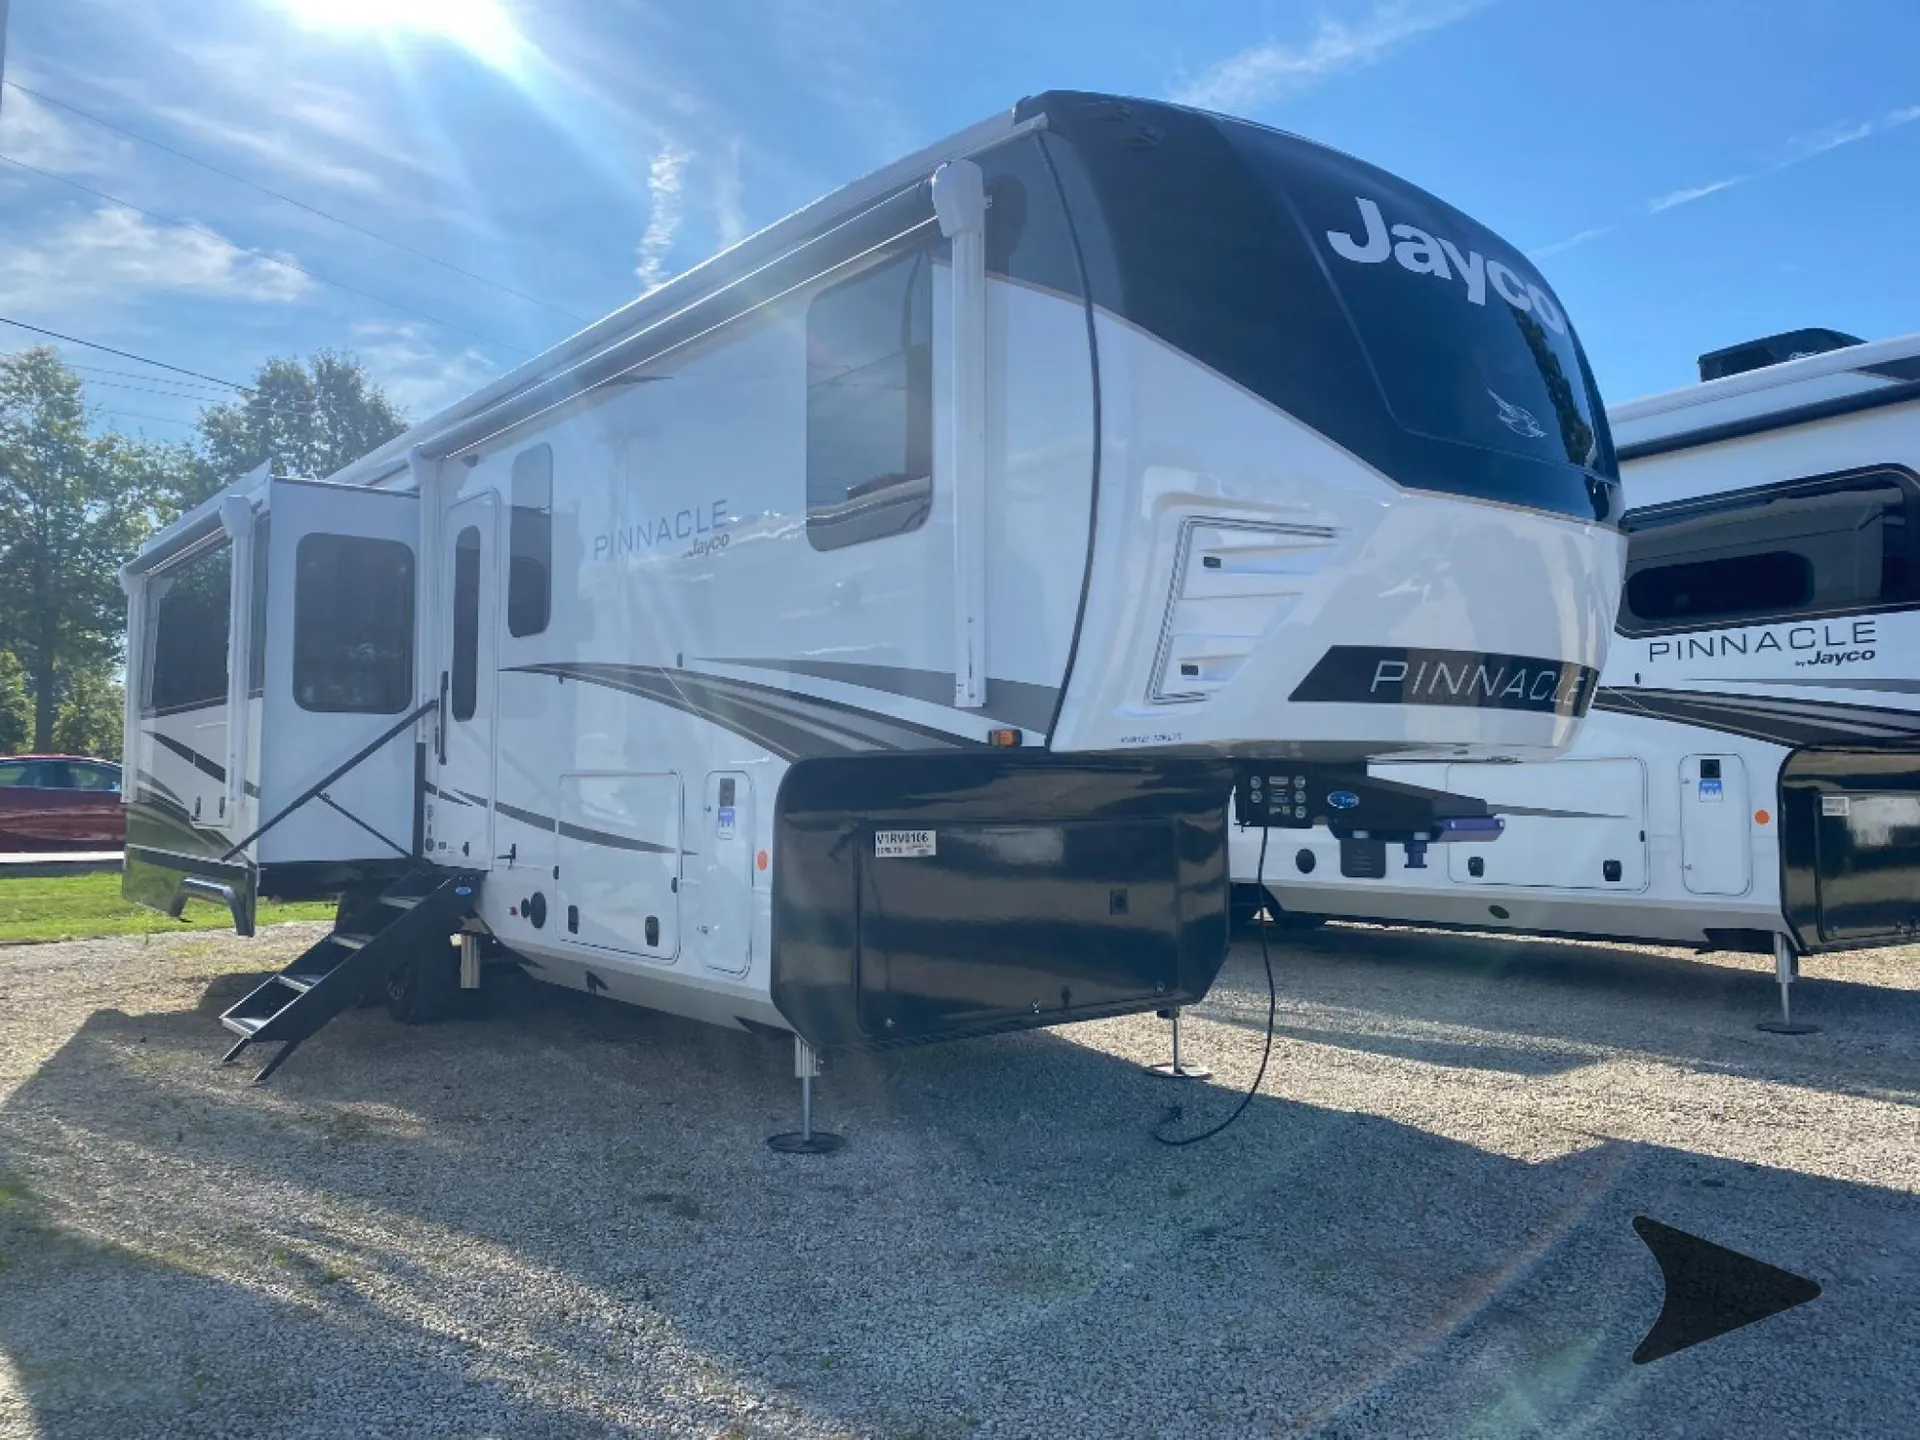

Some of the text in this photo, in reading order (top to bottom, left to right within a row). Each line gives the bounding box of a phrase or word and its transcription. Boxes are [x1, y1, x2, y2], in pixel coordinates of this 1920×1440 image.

[1326, 197, 1566, 335] Jayco
[594, 499, 728, 561] PINNACLE
[687, 533, 730, 557] Jayco
[1649, 620, 1877, 662] PINNACLE
[1807, 650, 1876, 666] Jayco
[1369, 659, 1585, 706] PINNACLE
